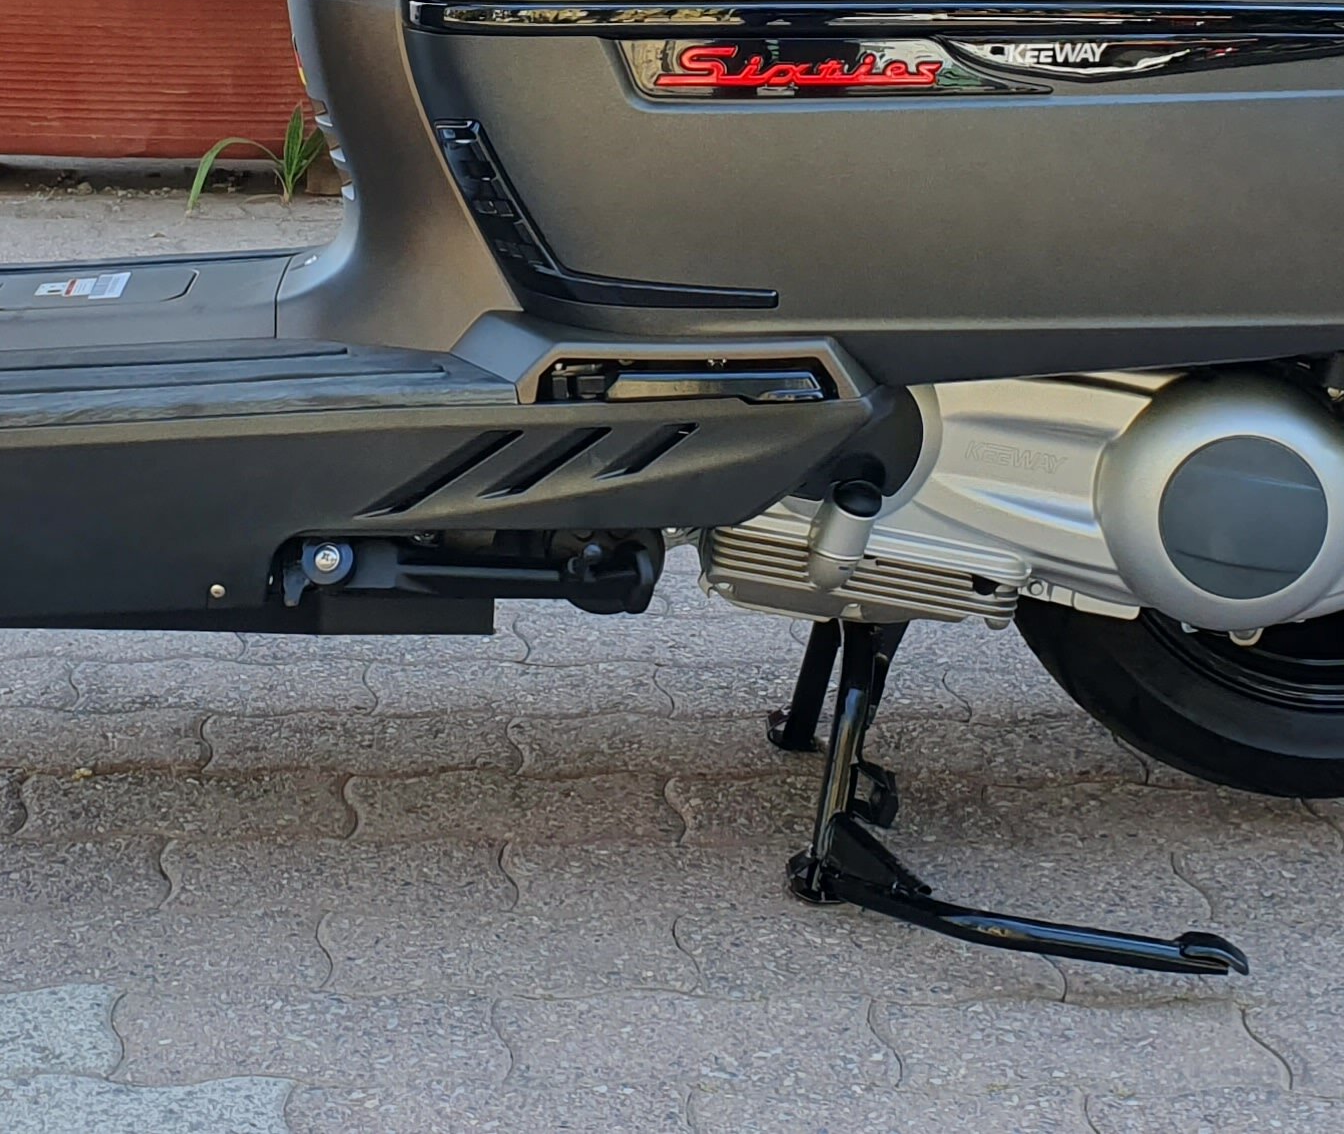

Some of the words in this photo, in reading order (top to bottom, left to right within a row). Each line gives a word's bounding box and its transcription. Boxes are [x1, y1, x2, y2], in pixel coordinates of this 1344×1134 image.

[654, 45, 944, 87] Sixties
[1007, 42, 1107, 64] KEEWAY
[964, 440, 1069, 474] KEEWAY
